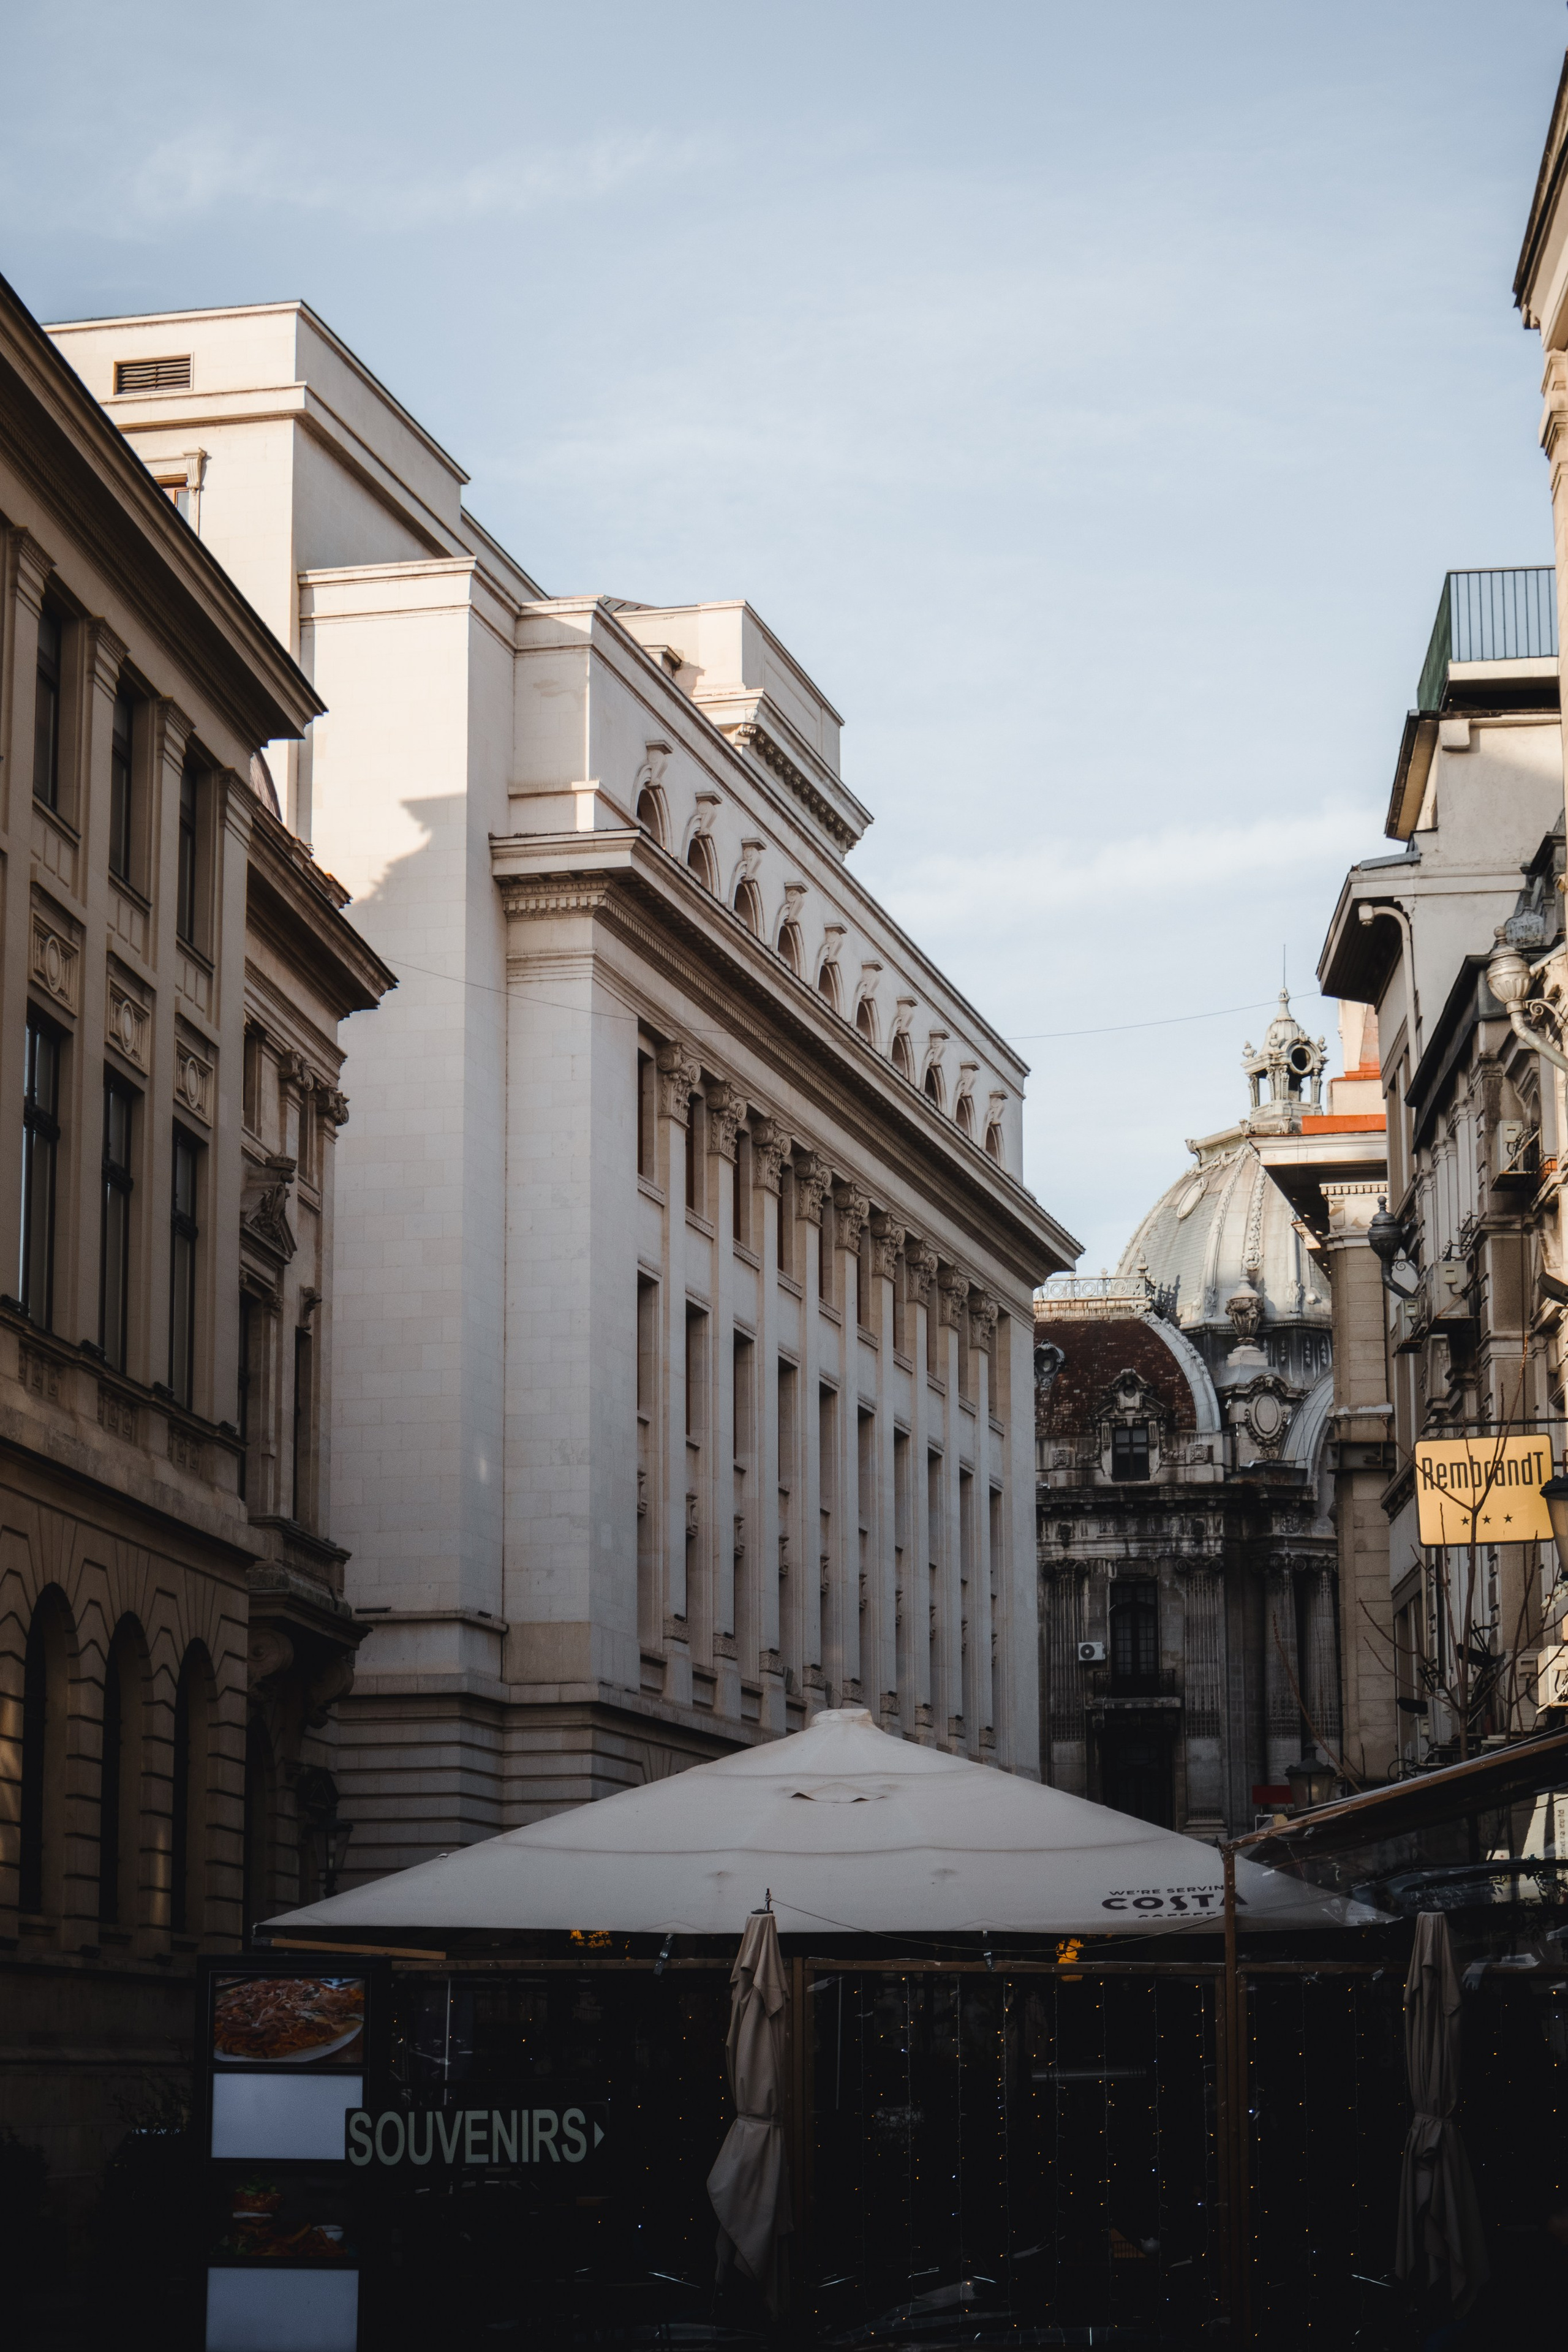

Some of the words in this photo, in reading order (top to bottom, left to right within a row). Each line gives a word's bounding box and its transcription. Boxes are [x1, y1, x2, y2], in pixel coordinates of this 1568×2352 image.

[1167, 1885, 1227, 1893] SERVIN
[1102, 1894, 1248, 1910] COSTA
[348, 2108, 587, 2166] SOUVENIRS
